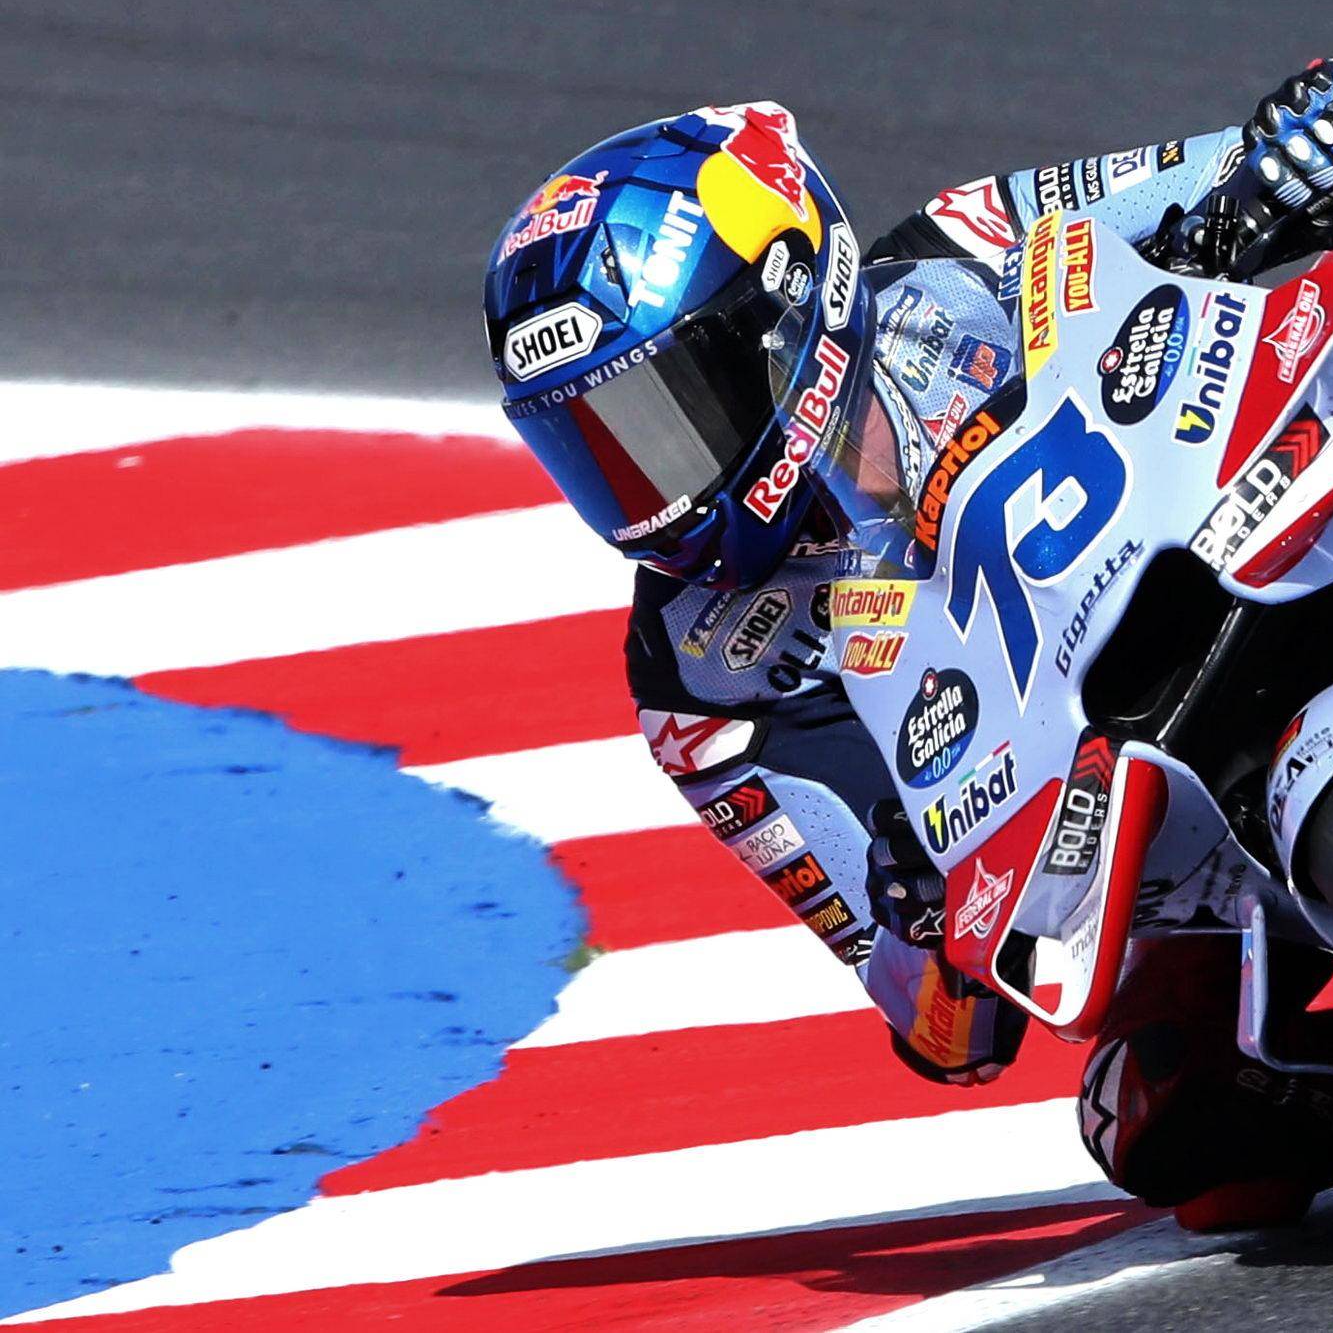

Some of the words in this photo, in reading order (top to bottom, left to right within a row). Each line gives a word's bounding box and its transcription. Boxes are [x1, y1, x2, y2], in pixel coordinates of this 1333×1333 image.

[536, 198, 598, 240] Bull
[628, 191, 705, 308] TONIT
[829, 233, 854, 319] SHOEI
[1027, 215, 1057, 352] Antangin
[1066, 220, 1091, 312] YOU-ALL
[511, 316, 584, 370] SHOEI
[541, 383, 577, 408] YOU
[584, 339, 658, 388] WINGS
[1112, 307, 1155, 405] Estrella
[1135, 307, 1175, 398] Galicia
[1175, 293, 1247, 444] Unibat
[743, 417, 820, 523] Red
[795, 335, 850, 434] Bull
[915, 412, 1001, 549] Kapriol
[943, 387, 1133, 717] 73
[731, 597, 787, 660] SHOEI
[1055, 539, 1144, 678] Gigetta
[908, 685, 963, 746] Estrella
[912, 713, 966, 768] Galicia
[923, 752, 1015, 853] Unibat
[1051, 788, 1096, 868] BOLD
